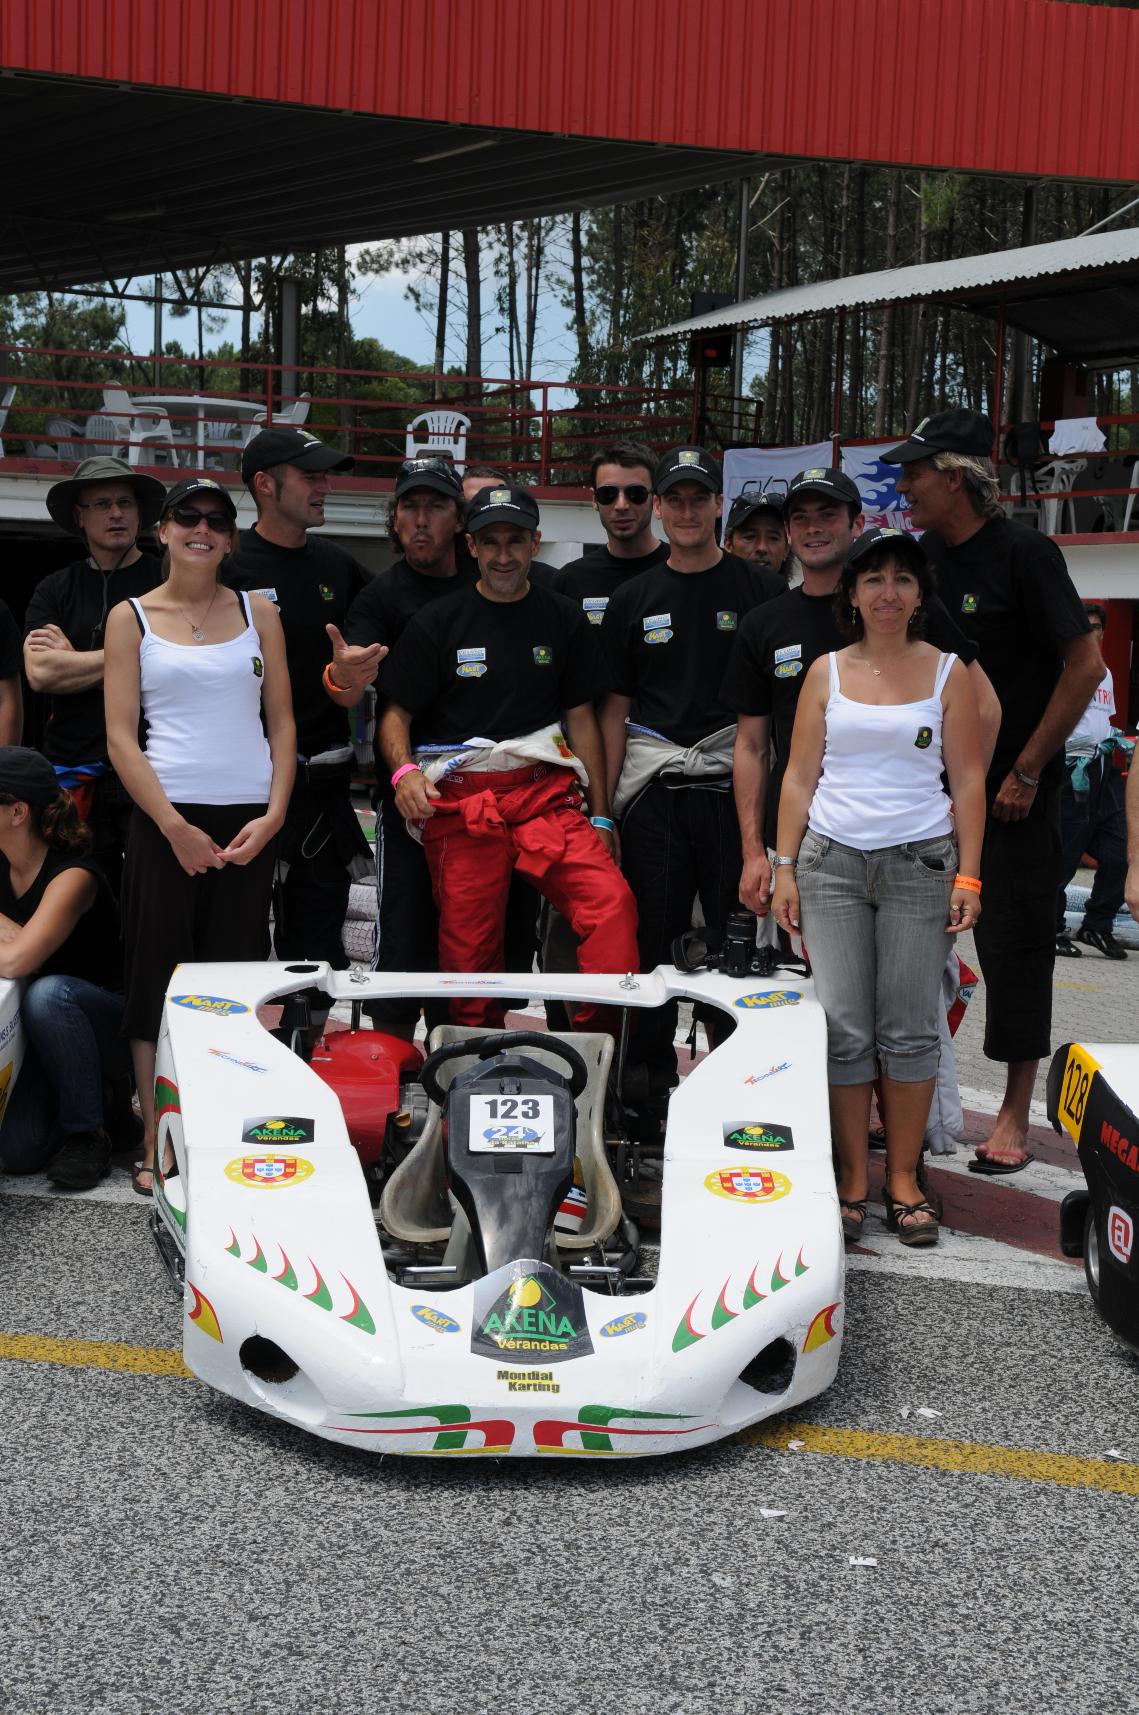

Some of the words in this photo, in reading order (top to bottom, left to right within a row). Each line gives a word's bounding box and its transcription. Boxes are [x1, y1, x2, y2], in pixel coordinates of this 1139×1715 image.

[744, 991, 788, 1008] KART
[1064, 1058, 1089, 1126] 128
[485, 1098, 540, 1119] 123
[249, 1128, 307, 1136] AKENA
[490, 1126, 526, 1139] 24
[730, 1132, 786, 1144] AKENA
[1100, 1120, 1139, 1173] MEGA
[417, 1306, 457, 1330] KART
[483, 1308, 577, 1338] AKENA
[606, 1315, 641, 1336] KART
[496, 1337, 569, 1351] Vérandas
[497, 1370, 553, 1381] Mondial
[508, 1381, 561, 1393] Karting
